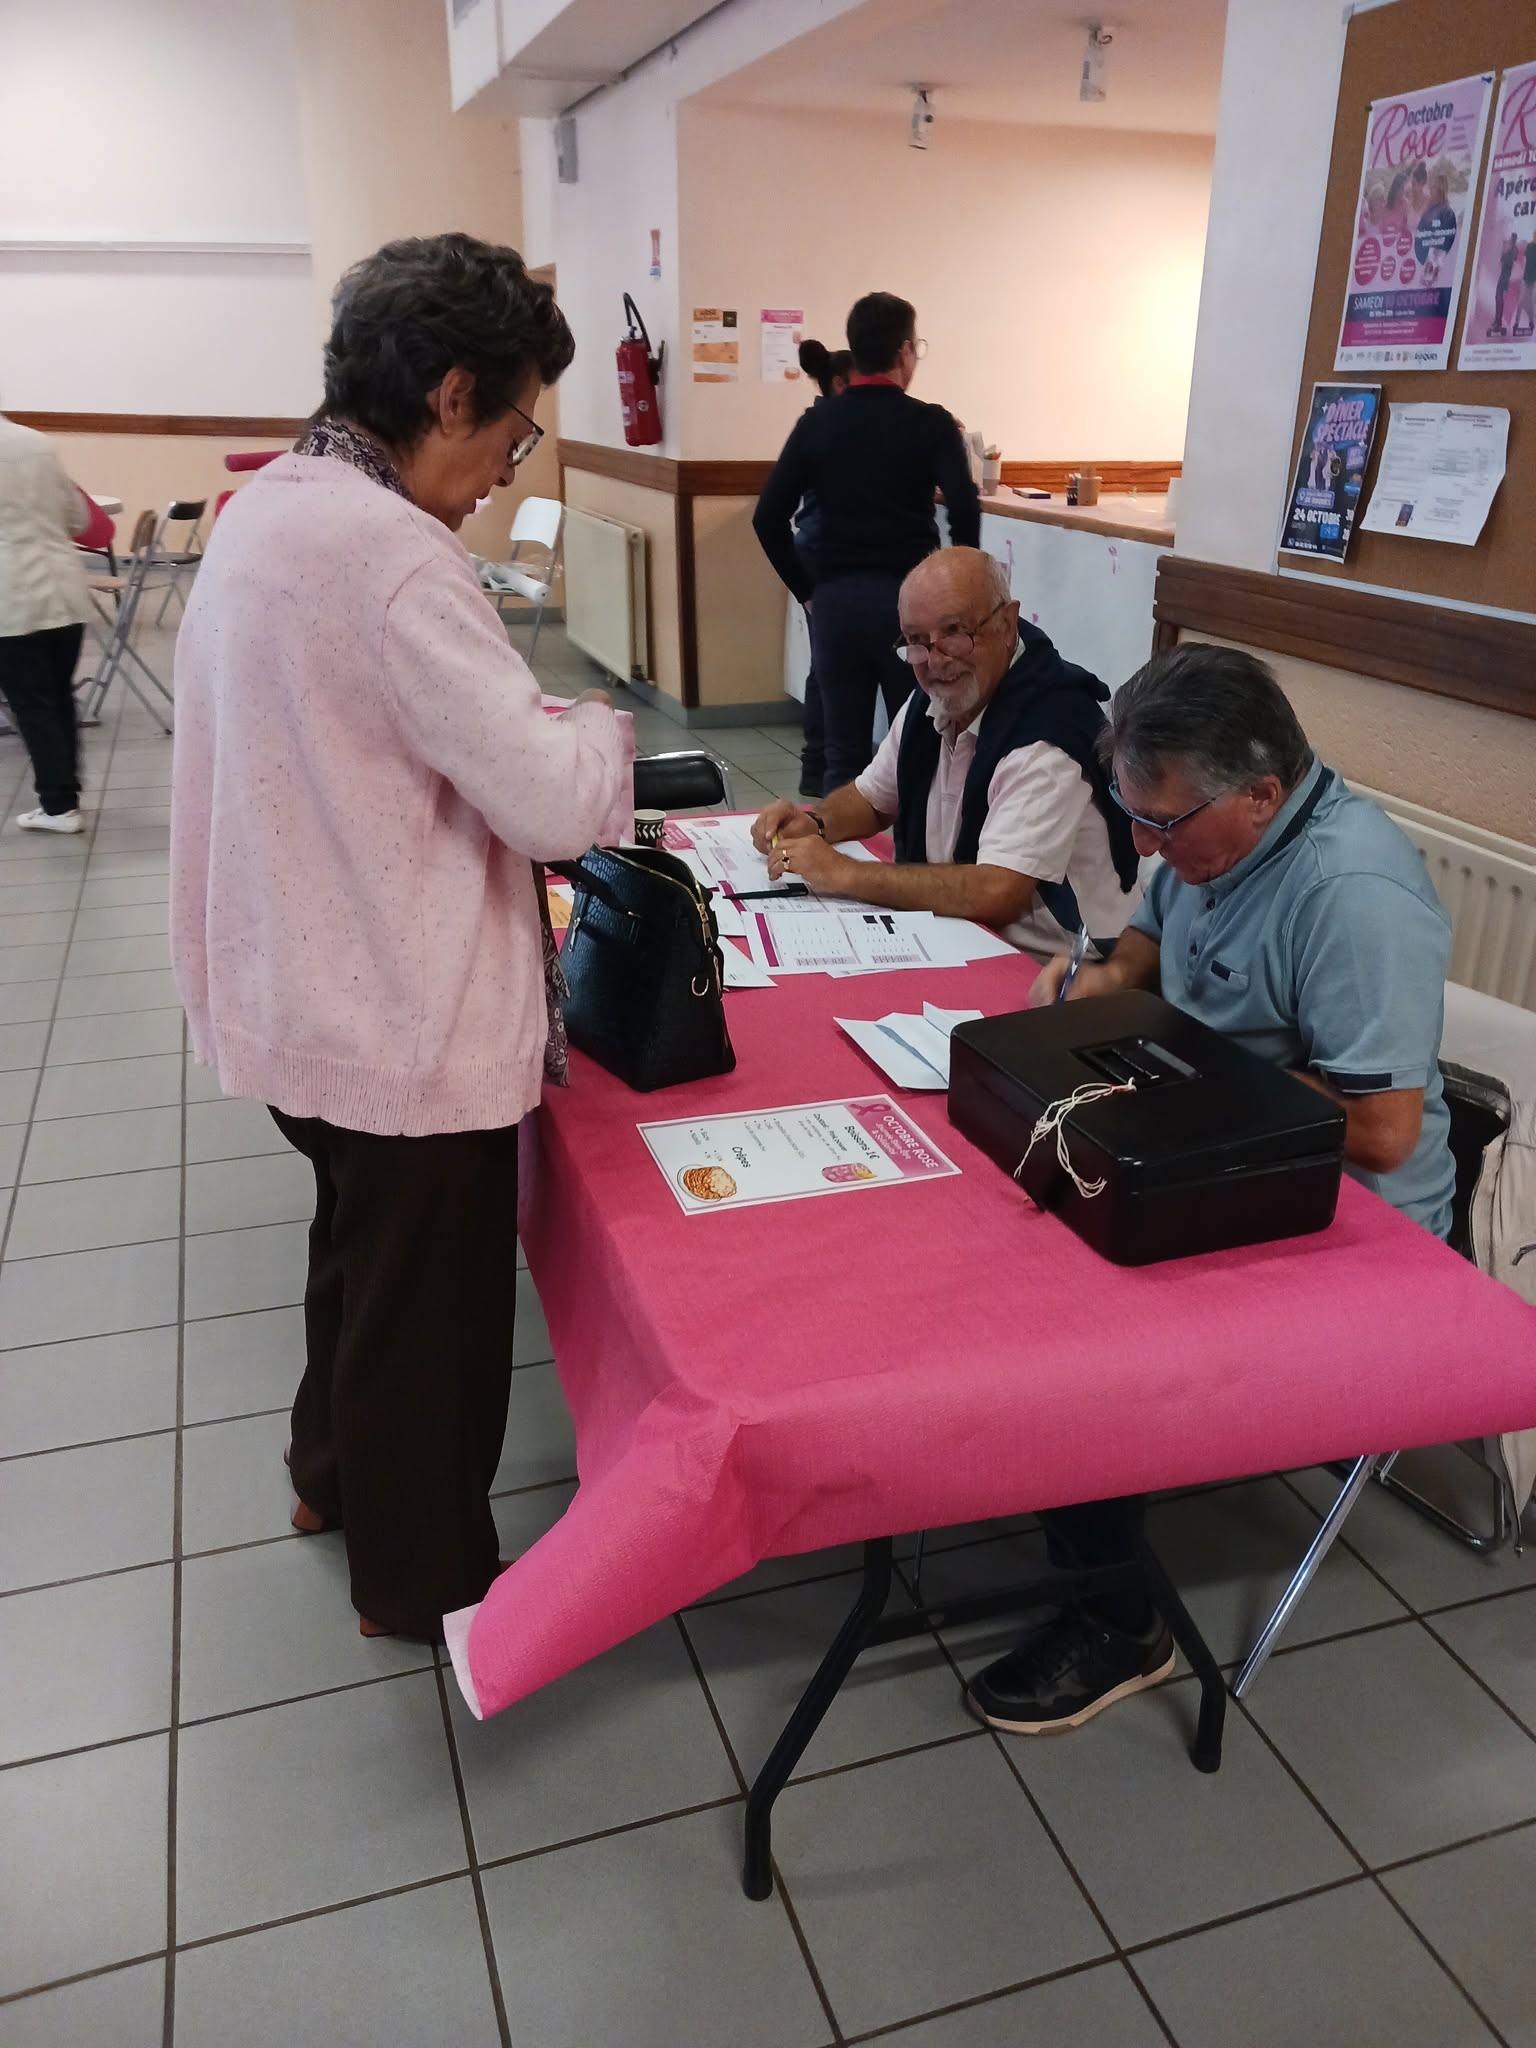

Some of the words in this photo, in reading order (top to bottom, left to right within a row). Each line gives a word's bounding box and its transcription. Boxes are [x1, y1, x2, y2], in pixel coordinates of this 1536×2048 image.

[1407, 101, 1454, 127] octobre
[1370, 103, 1448, 168] Rose
[1354, 295, 1384, 311] SAMEDI
[1315, 420, 1369, 443] SPECTACLE
[843, 1125, 870, 1151] Boissons
[883, 1115, 919, 1149] OCTOBRE
[912, 1148, 939, 1168] ROSE
[731, 1145, 752, 1168] Crêpes
